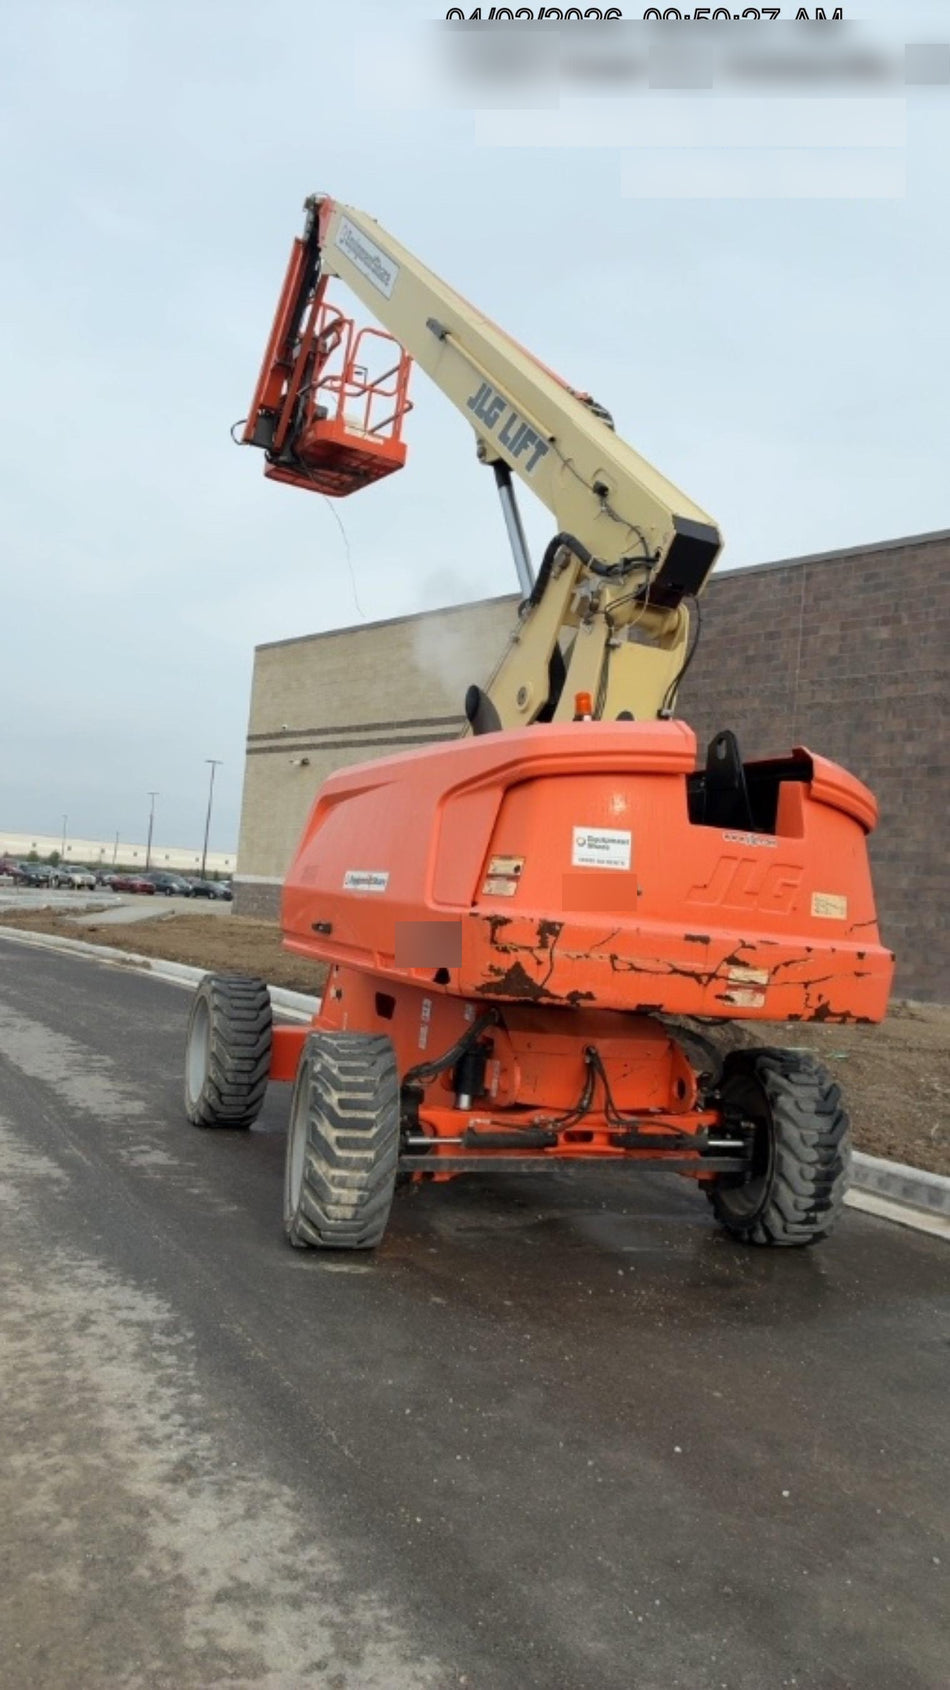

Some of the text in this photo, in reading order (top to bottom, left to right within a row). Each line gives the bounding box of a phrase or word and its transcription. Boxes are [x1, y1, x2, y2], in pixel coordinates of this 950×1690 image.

[466, 382, 550, 473] JLG LIFT
[684, 855, 804, 915] JLG
